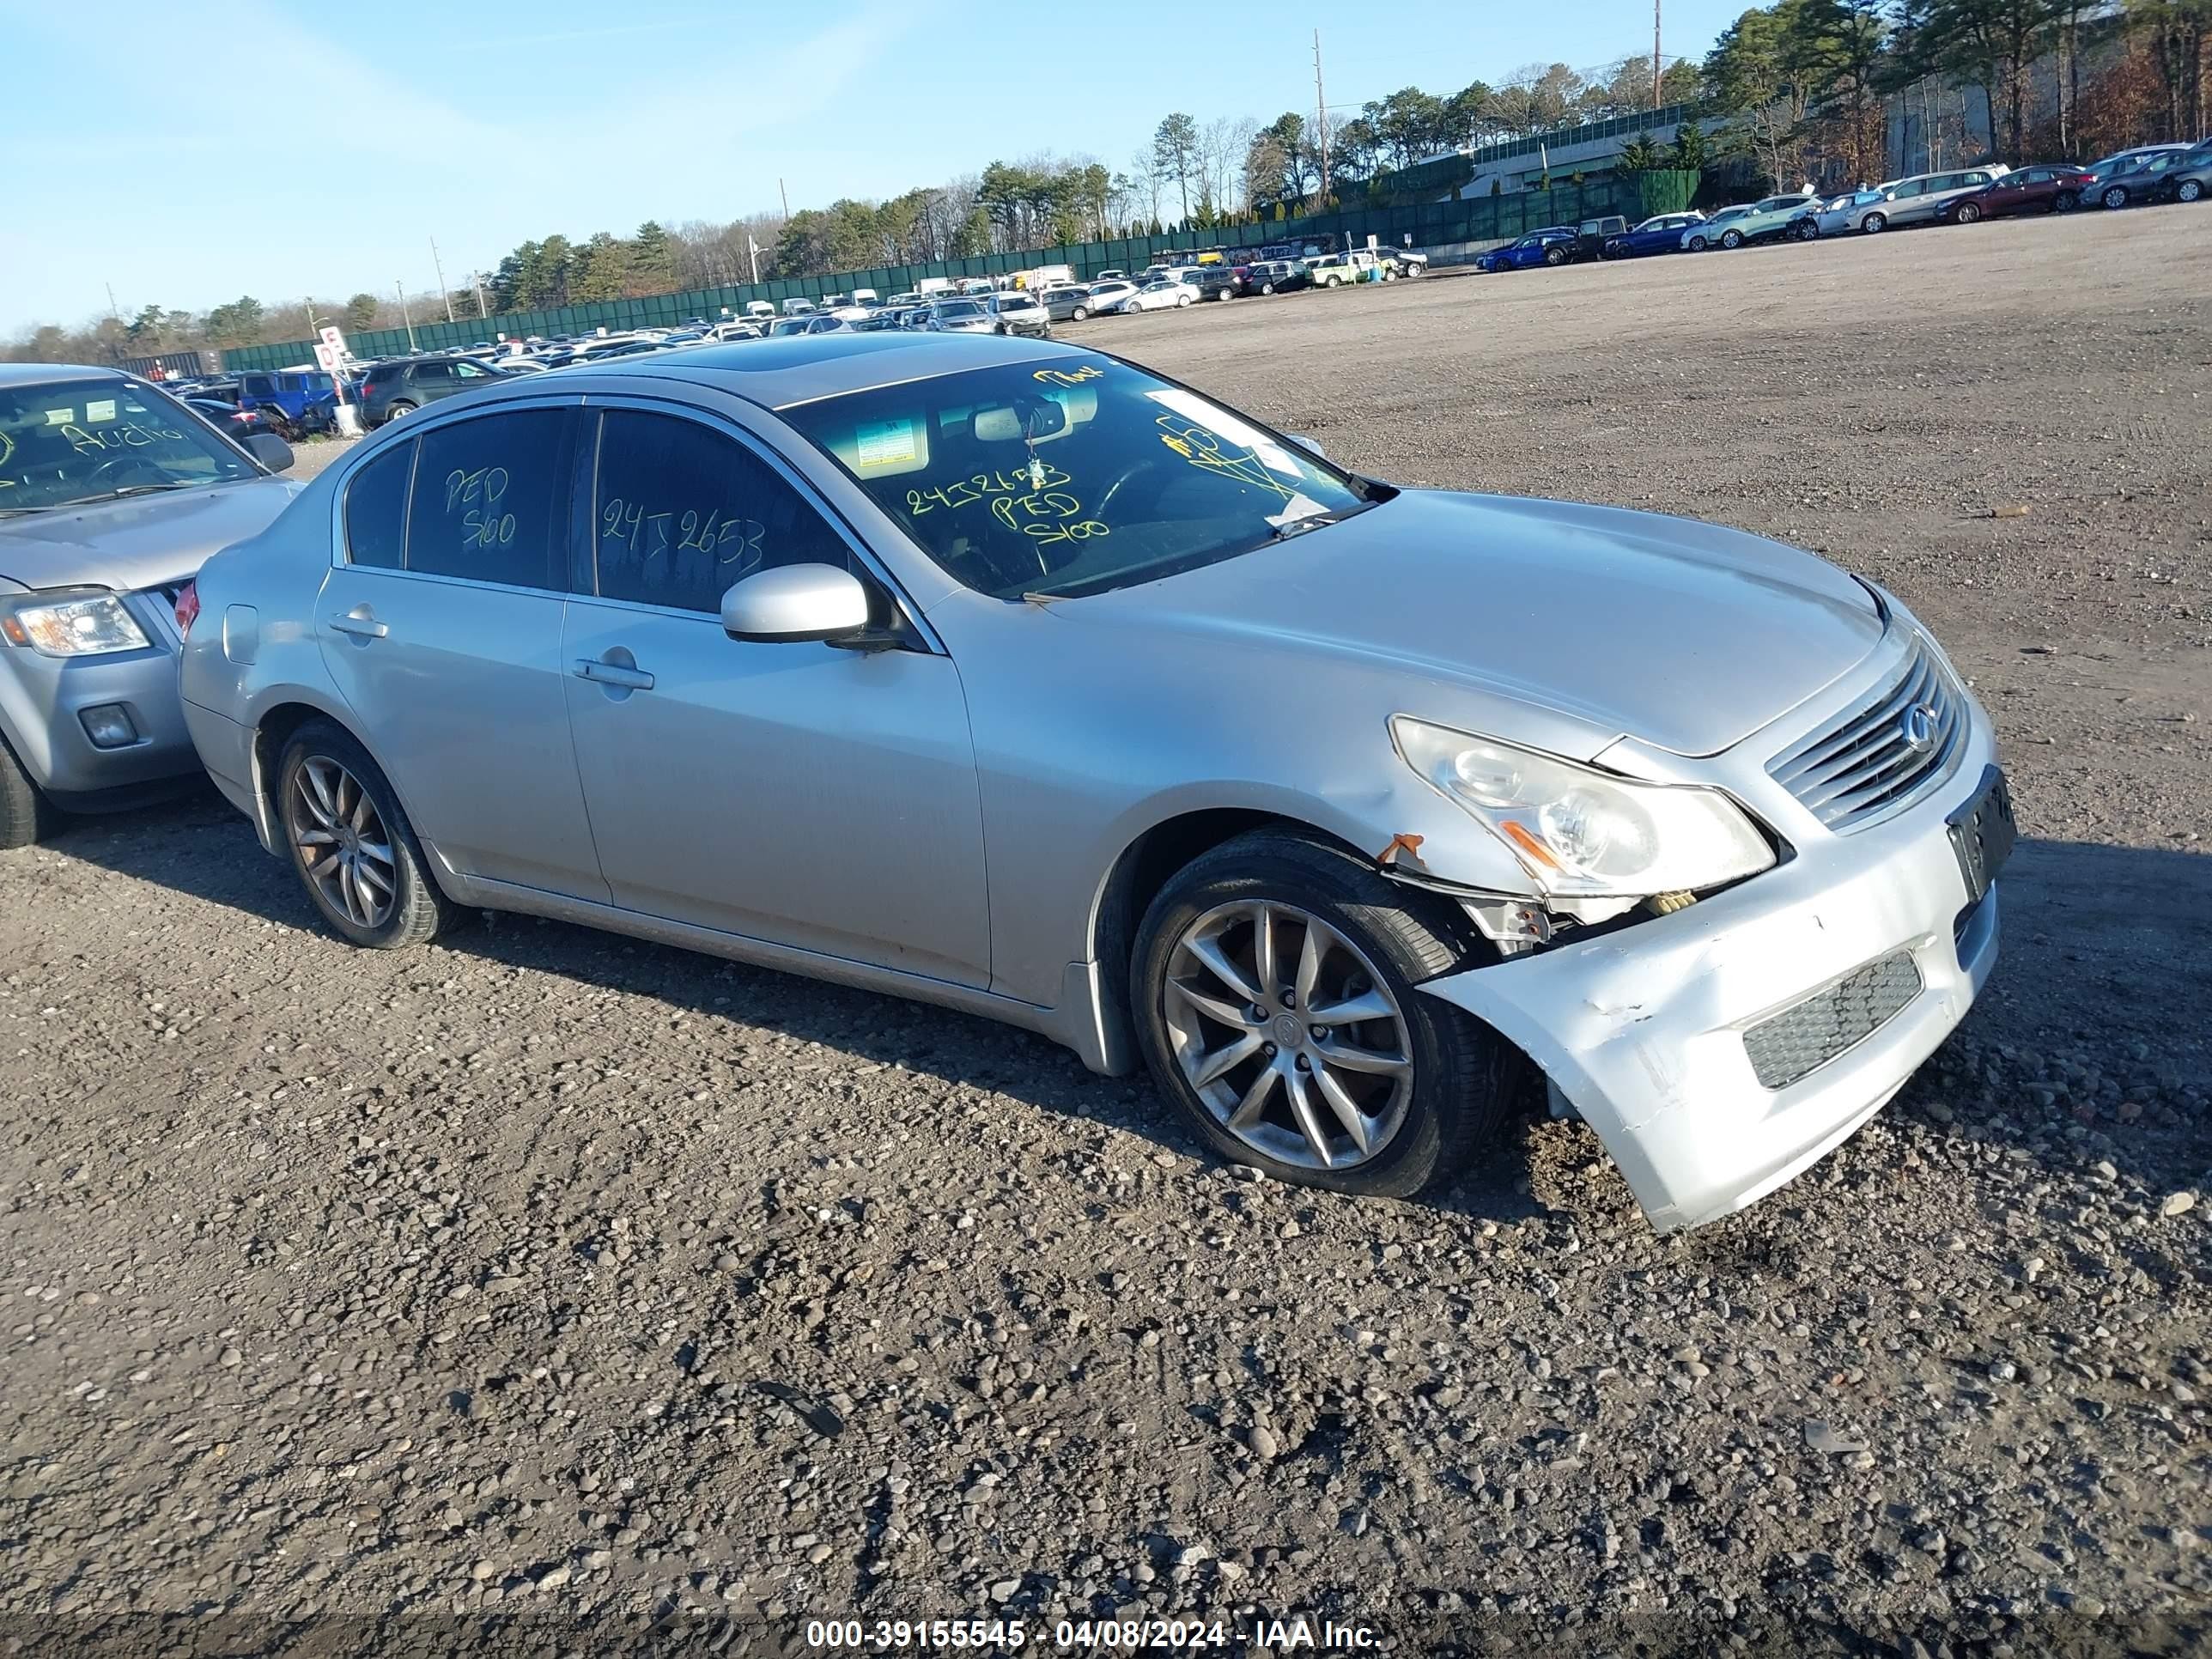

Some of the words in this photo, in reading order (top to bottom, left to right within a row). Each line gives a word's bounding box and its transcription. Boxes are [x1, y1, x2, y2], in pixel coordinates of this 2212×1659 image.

[446, 467, 508, 513] PED
[991, 492, 1080, 530] PED
[602, 498, 766, 574] 24J2653
